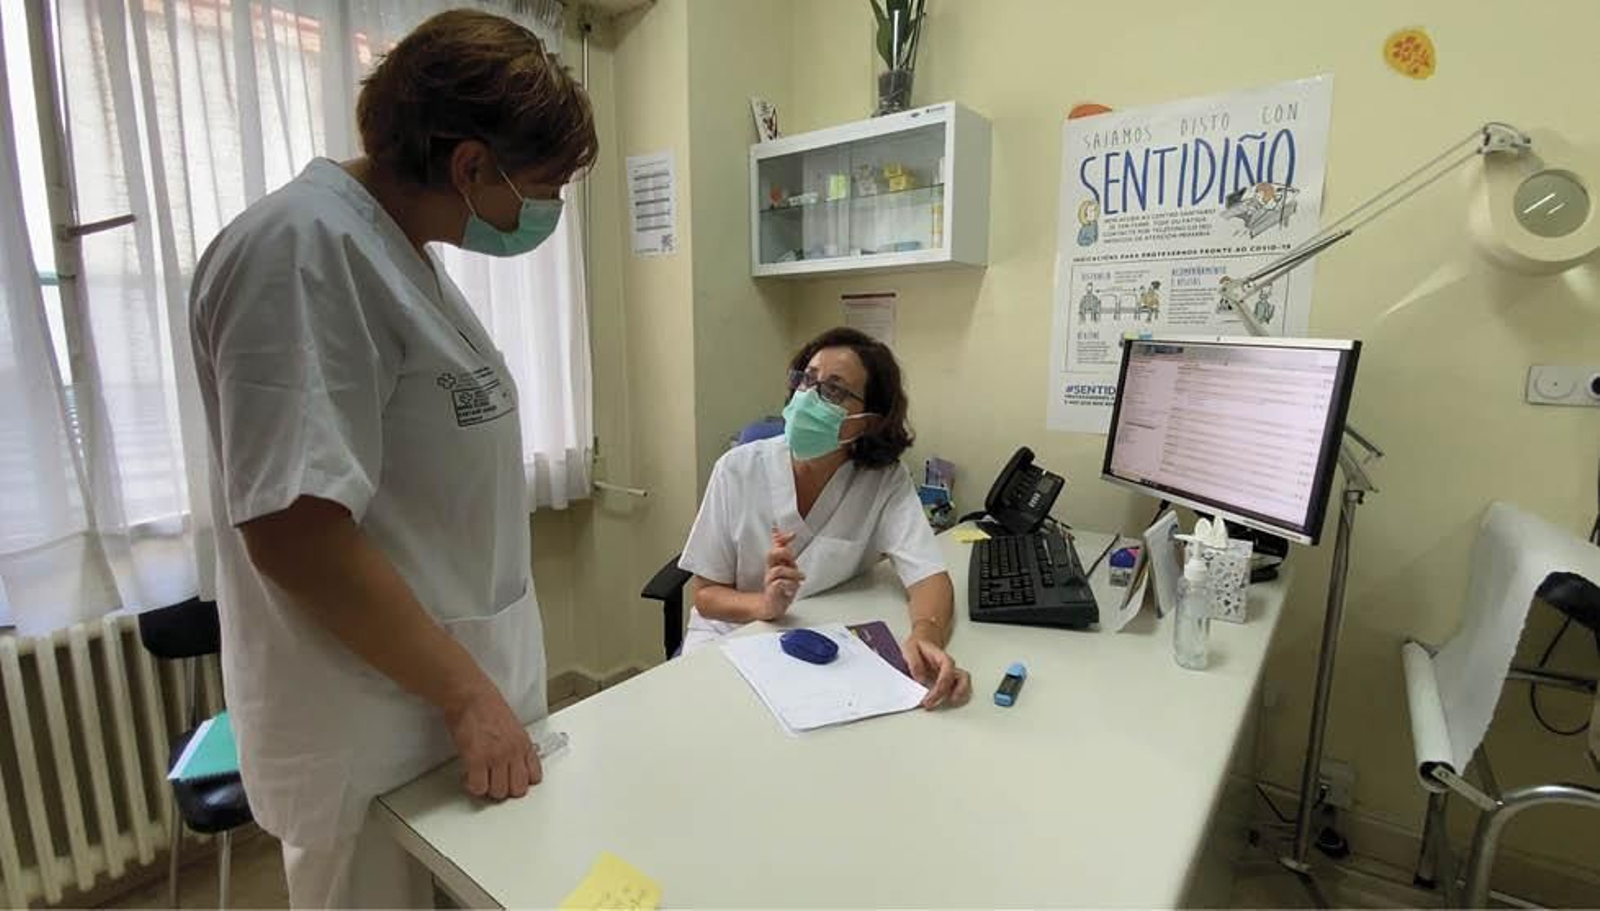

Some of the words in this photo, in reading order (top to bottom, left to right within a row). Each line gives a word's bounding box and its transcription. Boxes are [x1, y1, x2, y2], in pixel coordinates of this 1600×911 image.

[1083, 127, 1152, 149] SAIAMOS
[1180, 112, 1230, 136] DISTO
[1262, 102, 1299, 125] CON
[1080, 128, 1296, 215] SENTIDIÑO
